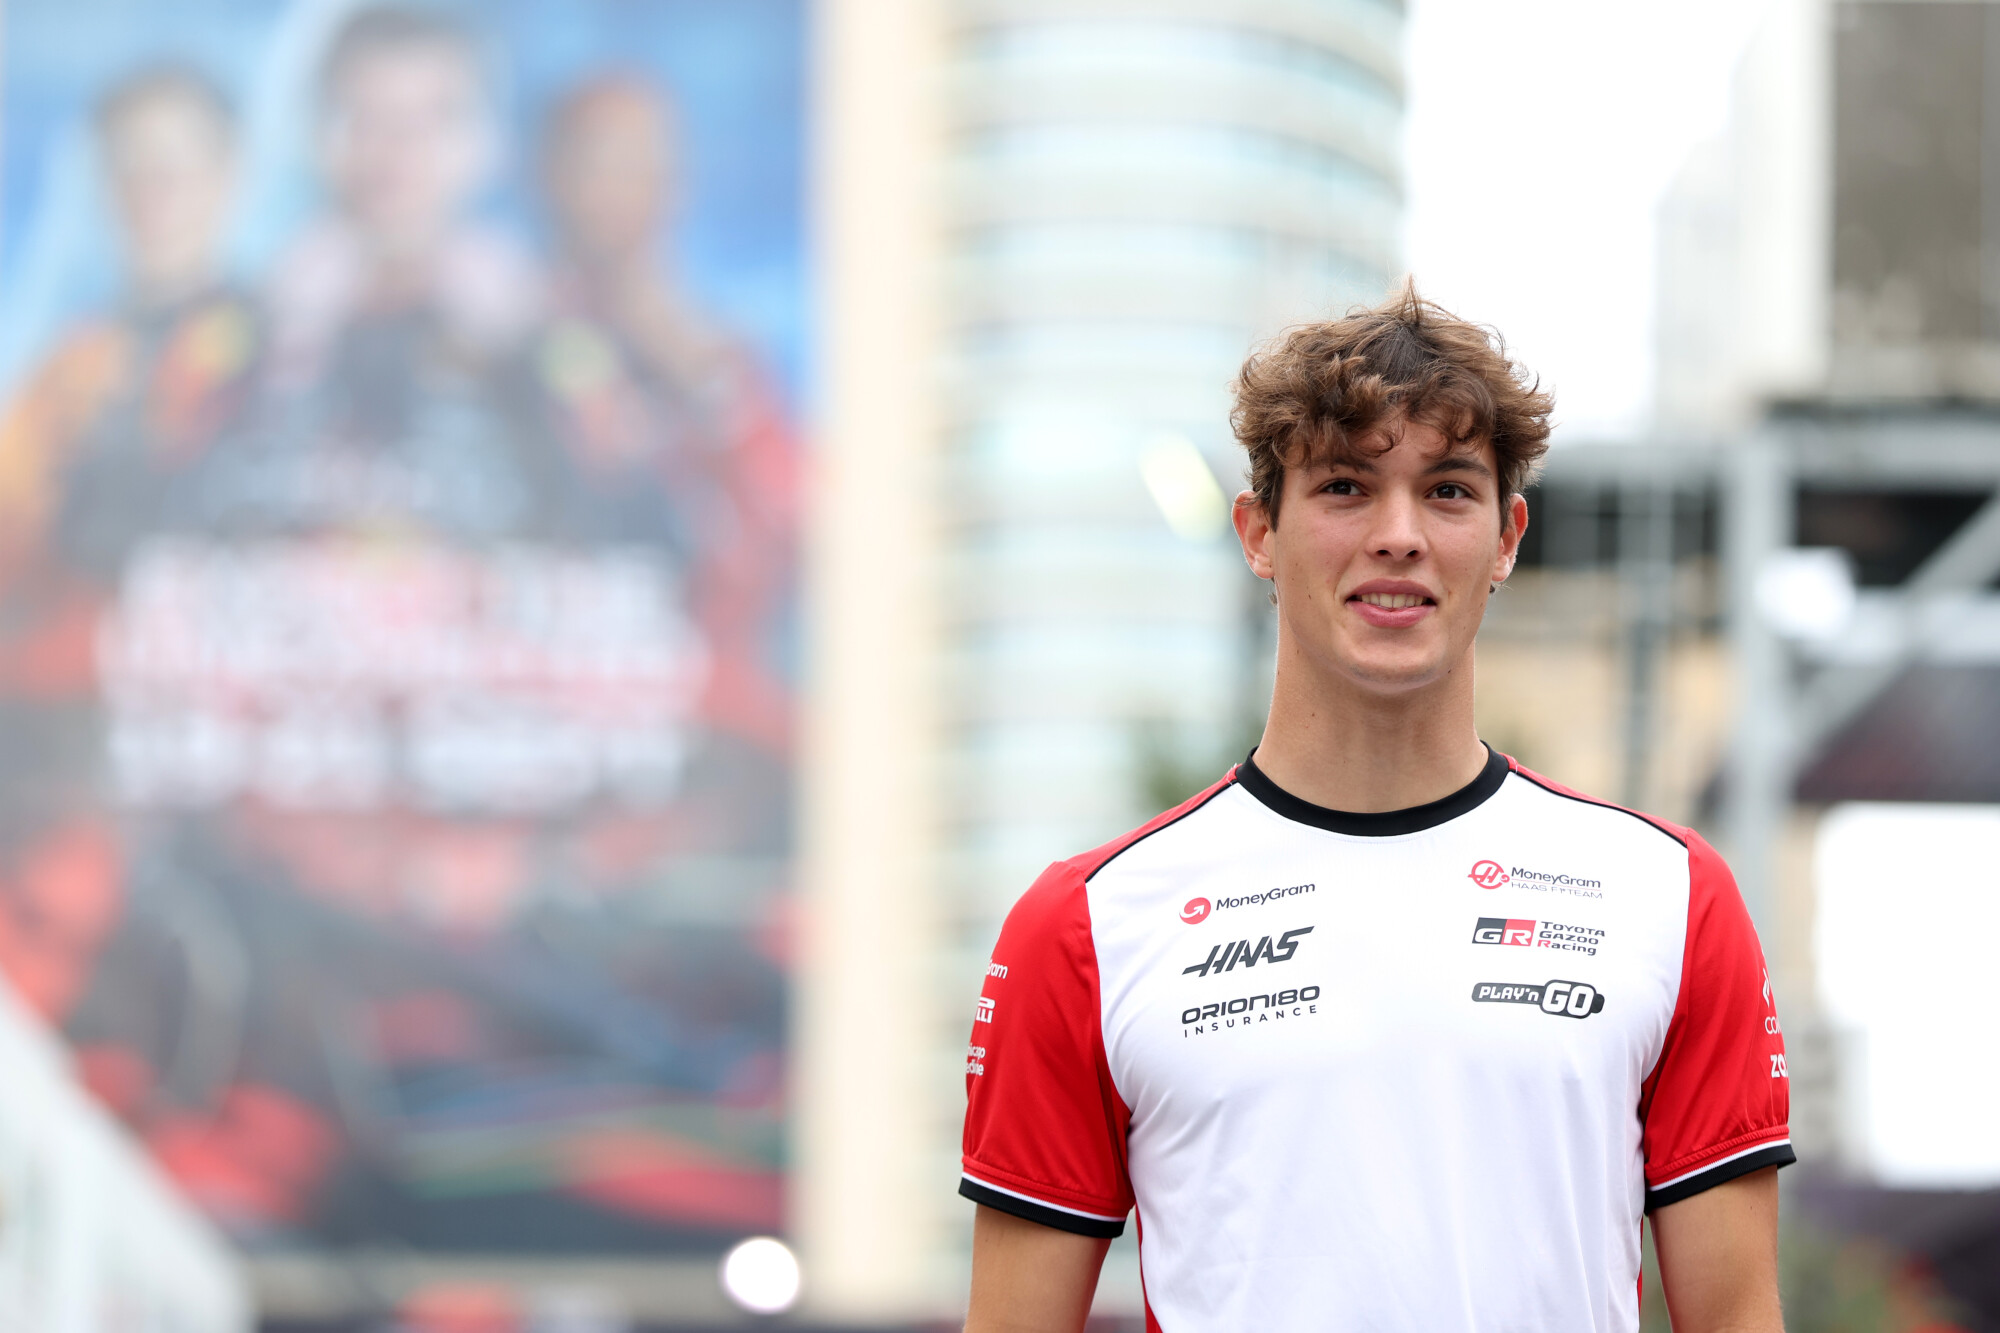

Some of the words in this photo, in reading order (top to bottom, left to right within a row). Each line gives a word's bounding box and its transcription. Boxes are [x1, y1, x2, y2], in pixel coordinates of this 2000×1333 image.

[1511, 867, 1601, 888] MoneyGram
[1216, 883, 1315, 911] MoneyGram
[1511, 882, 1547, 892] HAAS
[1569, 889, 1603, 899] TEAM
[1474, 927, 1532, 946] GR
[1539, 930, 1599, 945] GAZOO
[1540, 920, 1606, 937] TOYOTA
[1181, 925, 1315, 977] HAAS
[1537, 939, 1597, 956] Racing
[1181, 985, 1320, 1025] ORION180
[1541, 981, 1595, 1017] GO
[1184, 1004, 1317, 1038] INSURANCE
